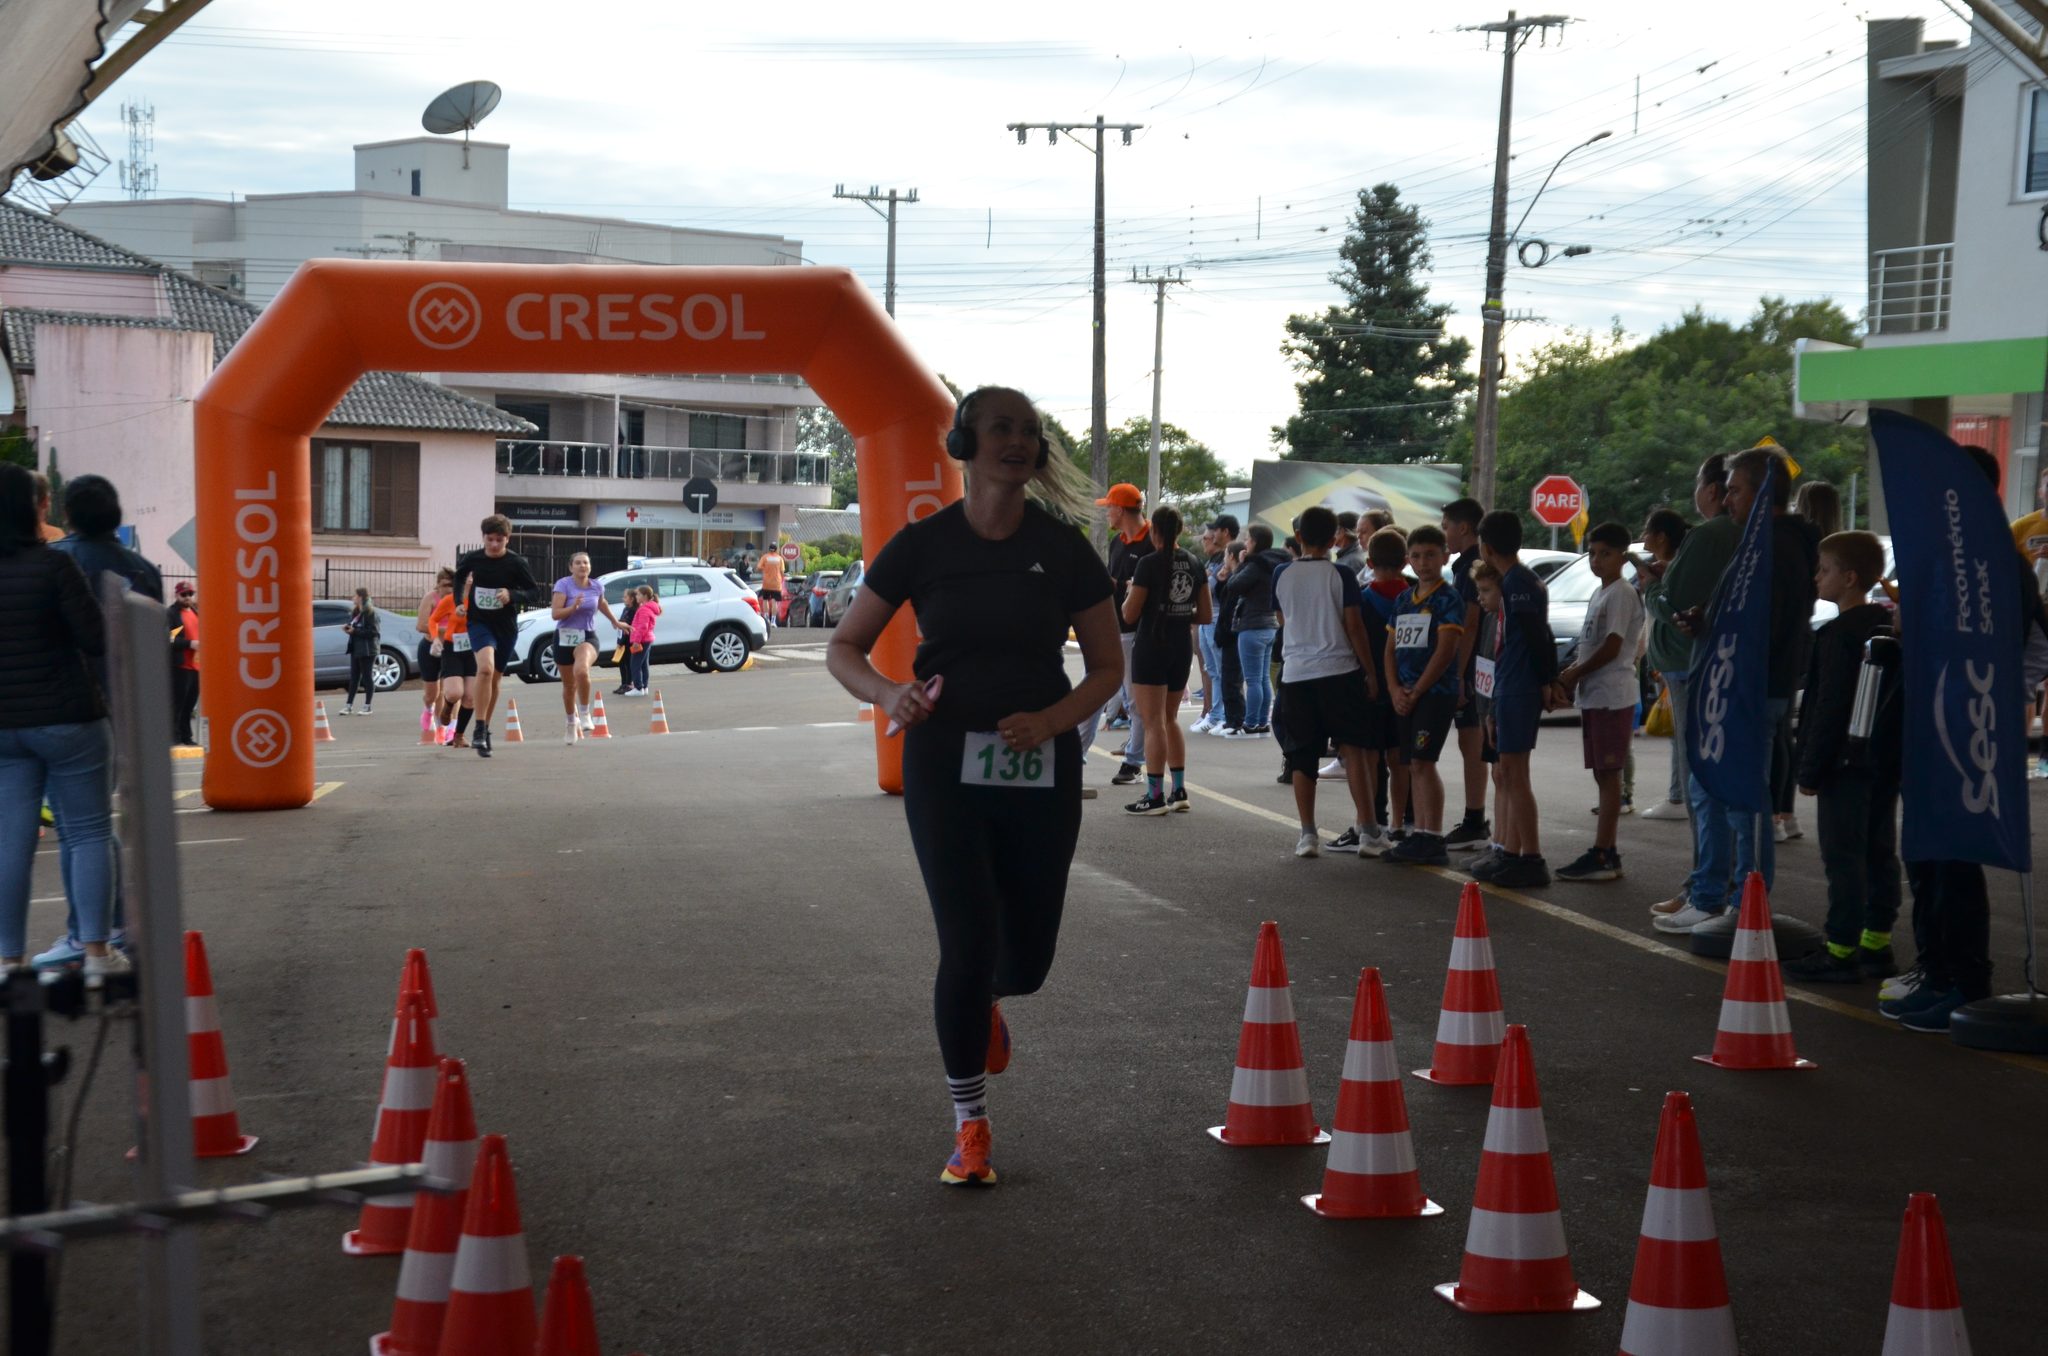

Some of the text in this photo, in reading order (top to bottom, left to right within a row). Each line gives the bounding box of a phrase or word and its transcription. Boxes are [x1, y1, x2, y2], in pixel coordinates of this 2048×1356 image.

[505, 293, 766, 340] CRESOL
[1536, 493, 1580, 508] PARE
[234, 470, 282, 690] CRESOL
[565, 634, 579, 645] 72
[1397, 626, 1424, 645] 987
[977, 743, 1044, 781] 136
